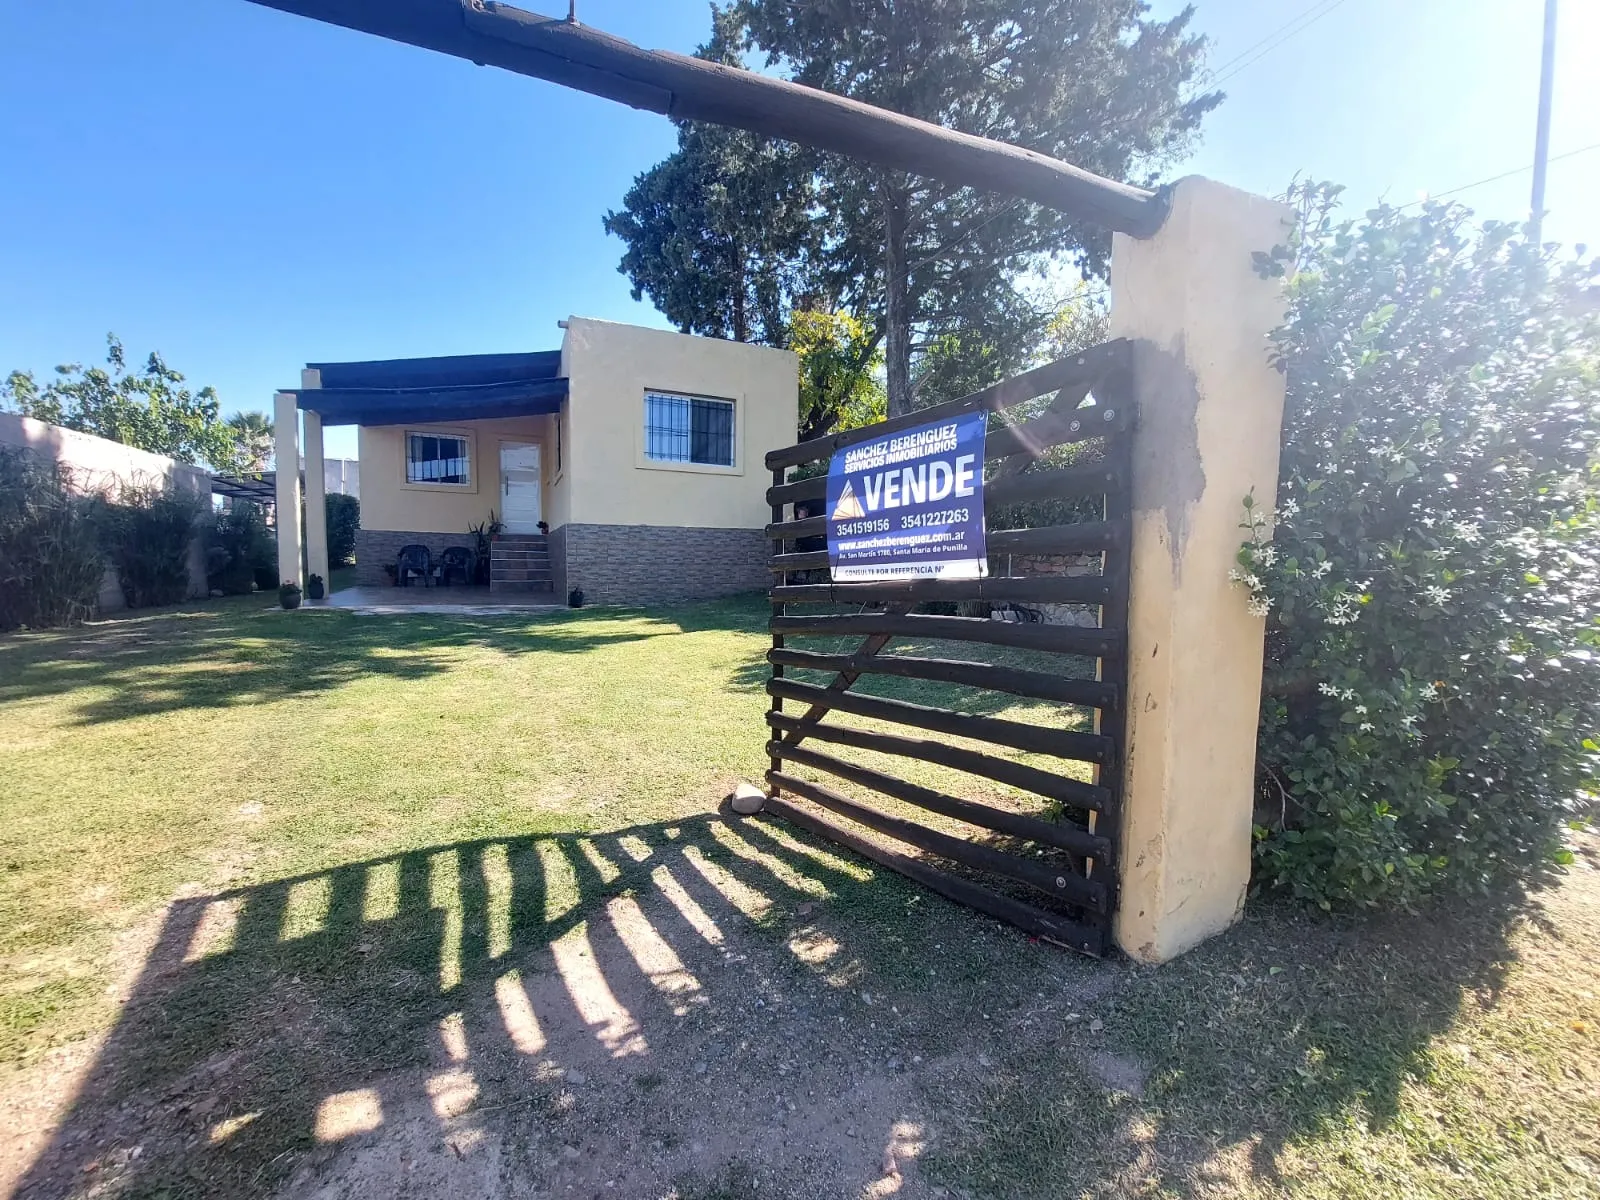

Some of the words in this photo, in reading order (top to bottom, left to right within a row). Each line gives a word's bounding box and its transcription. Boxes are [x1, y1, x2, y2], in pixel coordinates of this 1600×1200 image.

[844, 453, 885, 474] SERVICIOS
[885, 438, 958, 465] INMOBILIARIOS
[845, 443, 888, 464] SANCHEZ
[890, 423, 958, 452] BERENGUEZ
[863, 453, 975, 511] VENDE
[836, 518, 890, 537] 3541519156
[900, 508, 969, 529] 3541227263
[838, 531, 965, 551] www.sanchezberenguez.com.ar
[893, 547, 911, 555] Santa
[942, 543, 968, 551] Punilla
[876, 567, 889, 575] POR
[890, 566, 933, 575] REFERENCIA
